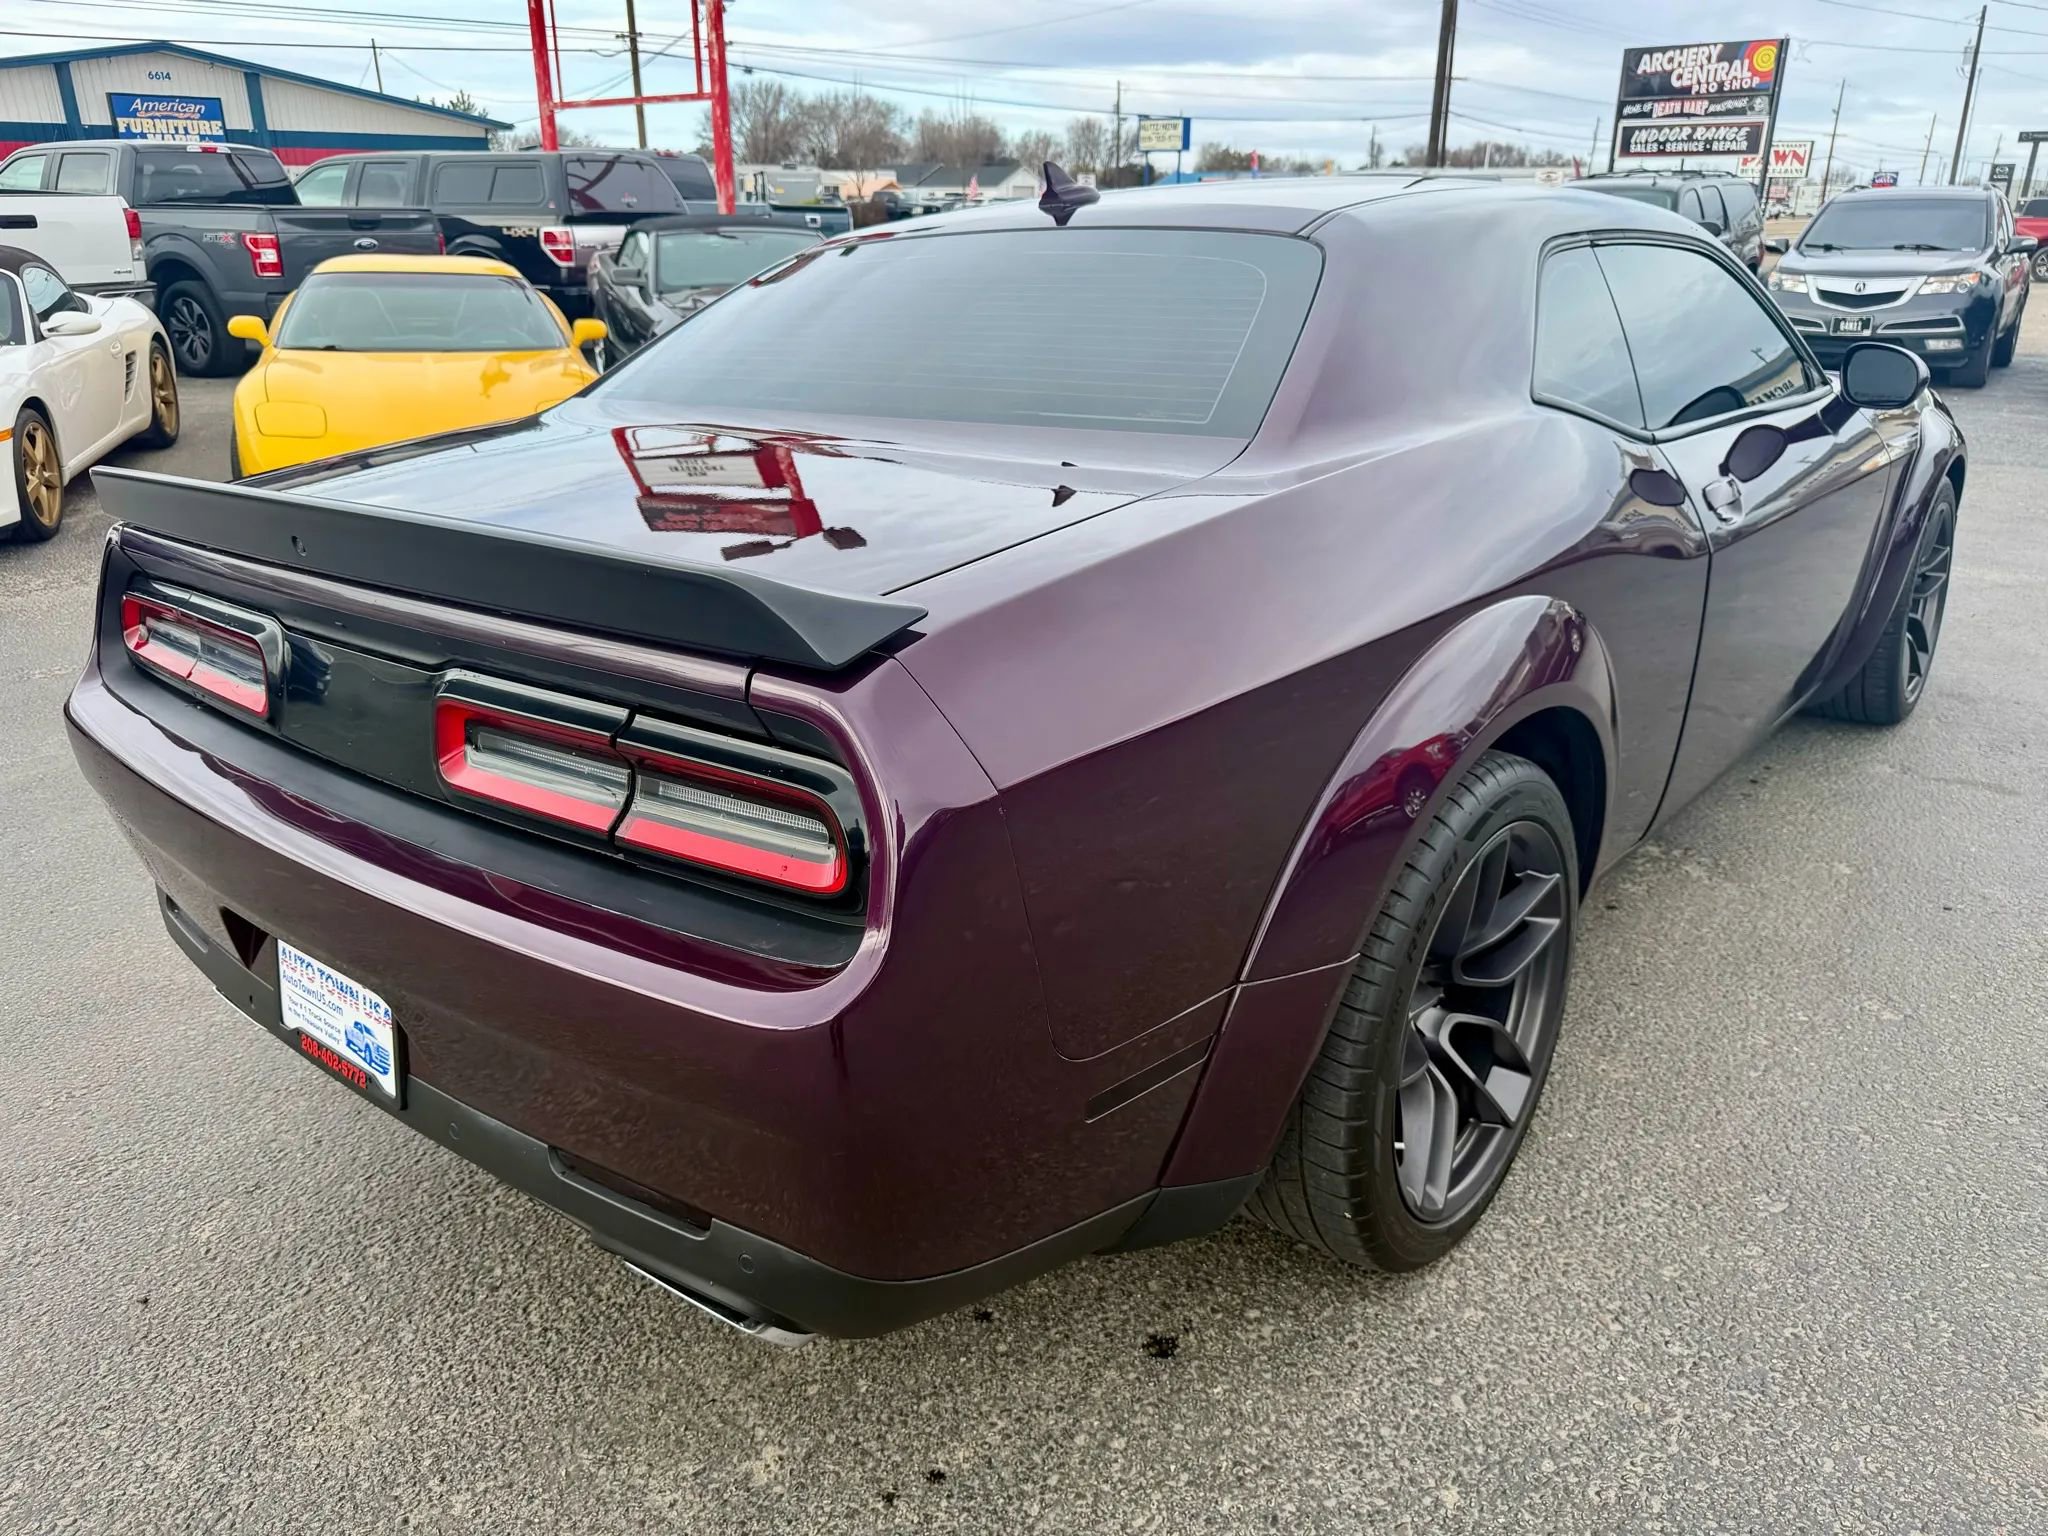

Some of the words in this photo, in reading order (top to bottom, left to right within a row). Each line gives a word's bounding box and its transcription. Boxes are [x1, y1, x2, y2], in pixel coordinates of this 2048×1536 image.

[1636, 44, 1724, 75] ARCHERY
[147, 71, 172, 81] 6614
[1670, 58, 1752, 88] CENTRAL
[1691, 82, 1718, 95] PRO
[1723, 77, 1760, 91] SHOP
[129, 98, 206, 114] American
[1651, 99, 1682, 118] DEATH
[116, 117, 224, 136] FURNITURE
[1630, 126, 1689, 144] INDOOR
[1693, 126, 1751, 142] RANGE
[1629, 142, 1659, 153] SALES
[1665, 141, 1705, 152] SERVICE
[1711, 140, 1748, 152] REPAIR
[1741, 149, 1807, 167] PWN
[281, 946, 315, 984] AUTO
[317, 967, 360, 1012] TOWN
[282, 969, 344, 1016] AutoTownUS.com
